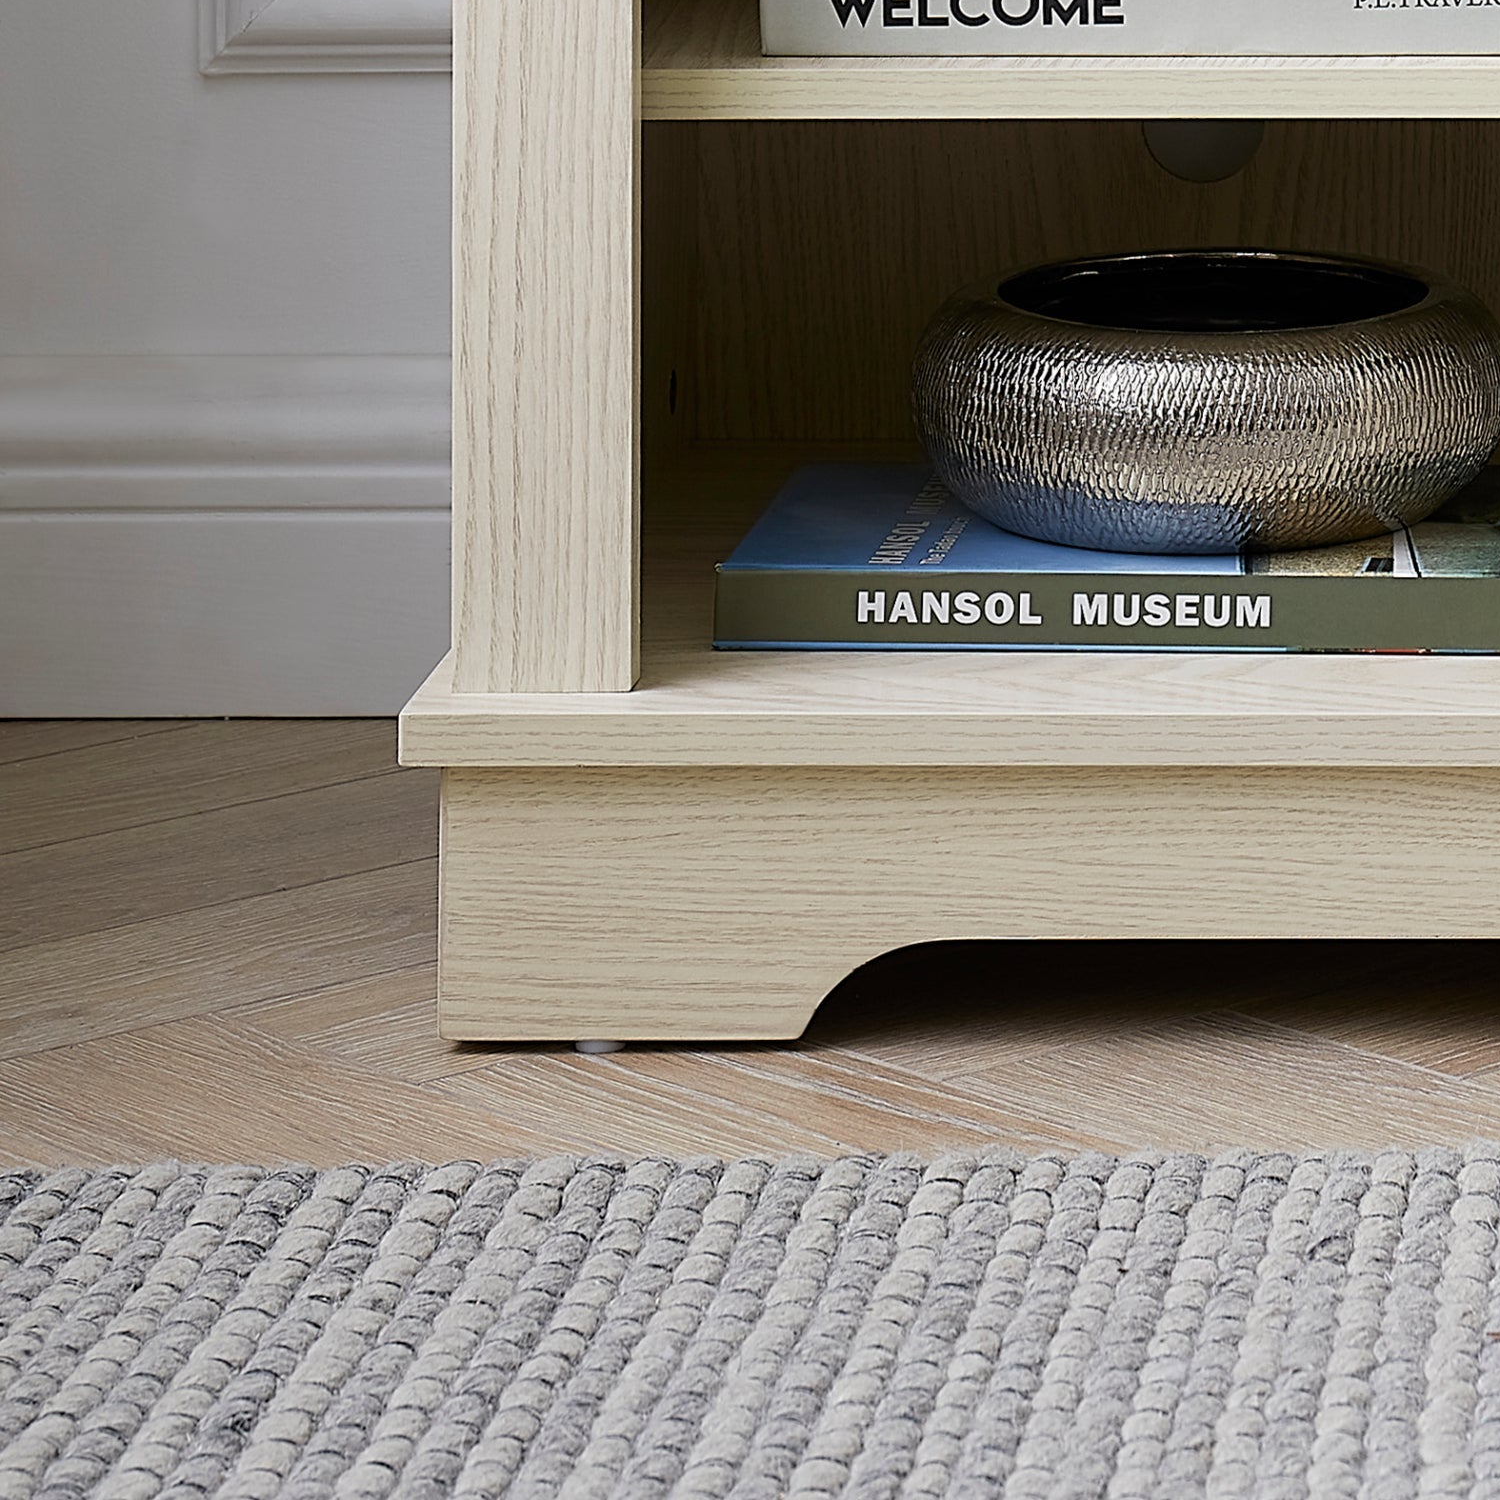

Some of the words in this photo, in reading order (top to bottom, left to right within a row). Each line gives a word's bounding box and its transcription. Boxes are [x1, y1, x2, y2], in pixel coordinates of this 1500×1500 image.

[868, 521, 930, 564] HANSOL
[857, 591, 1042, 625] HANSOL
[1072, 592, 1271, 628] MUSEUM
